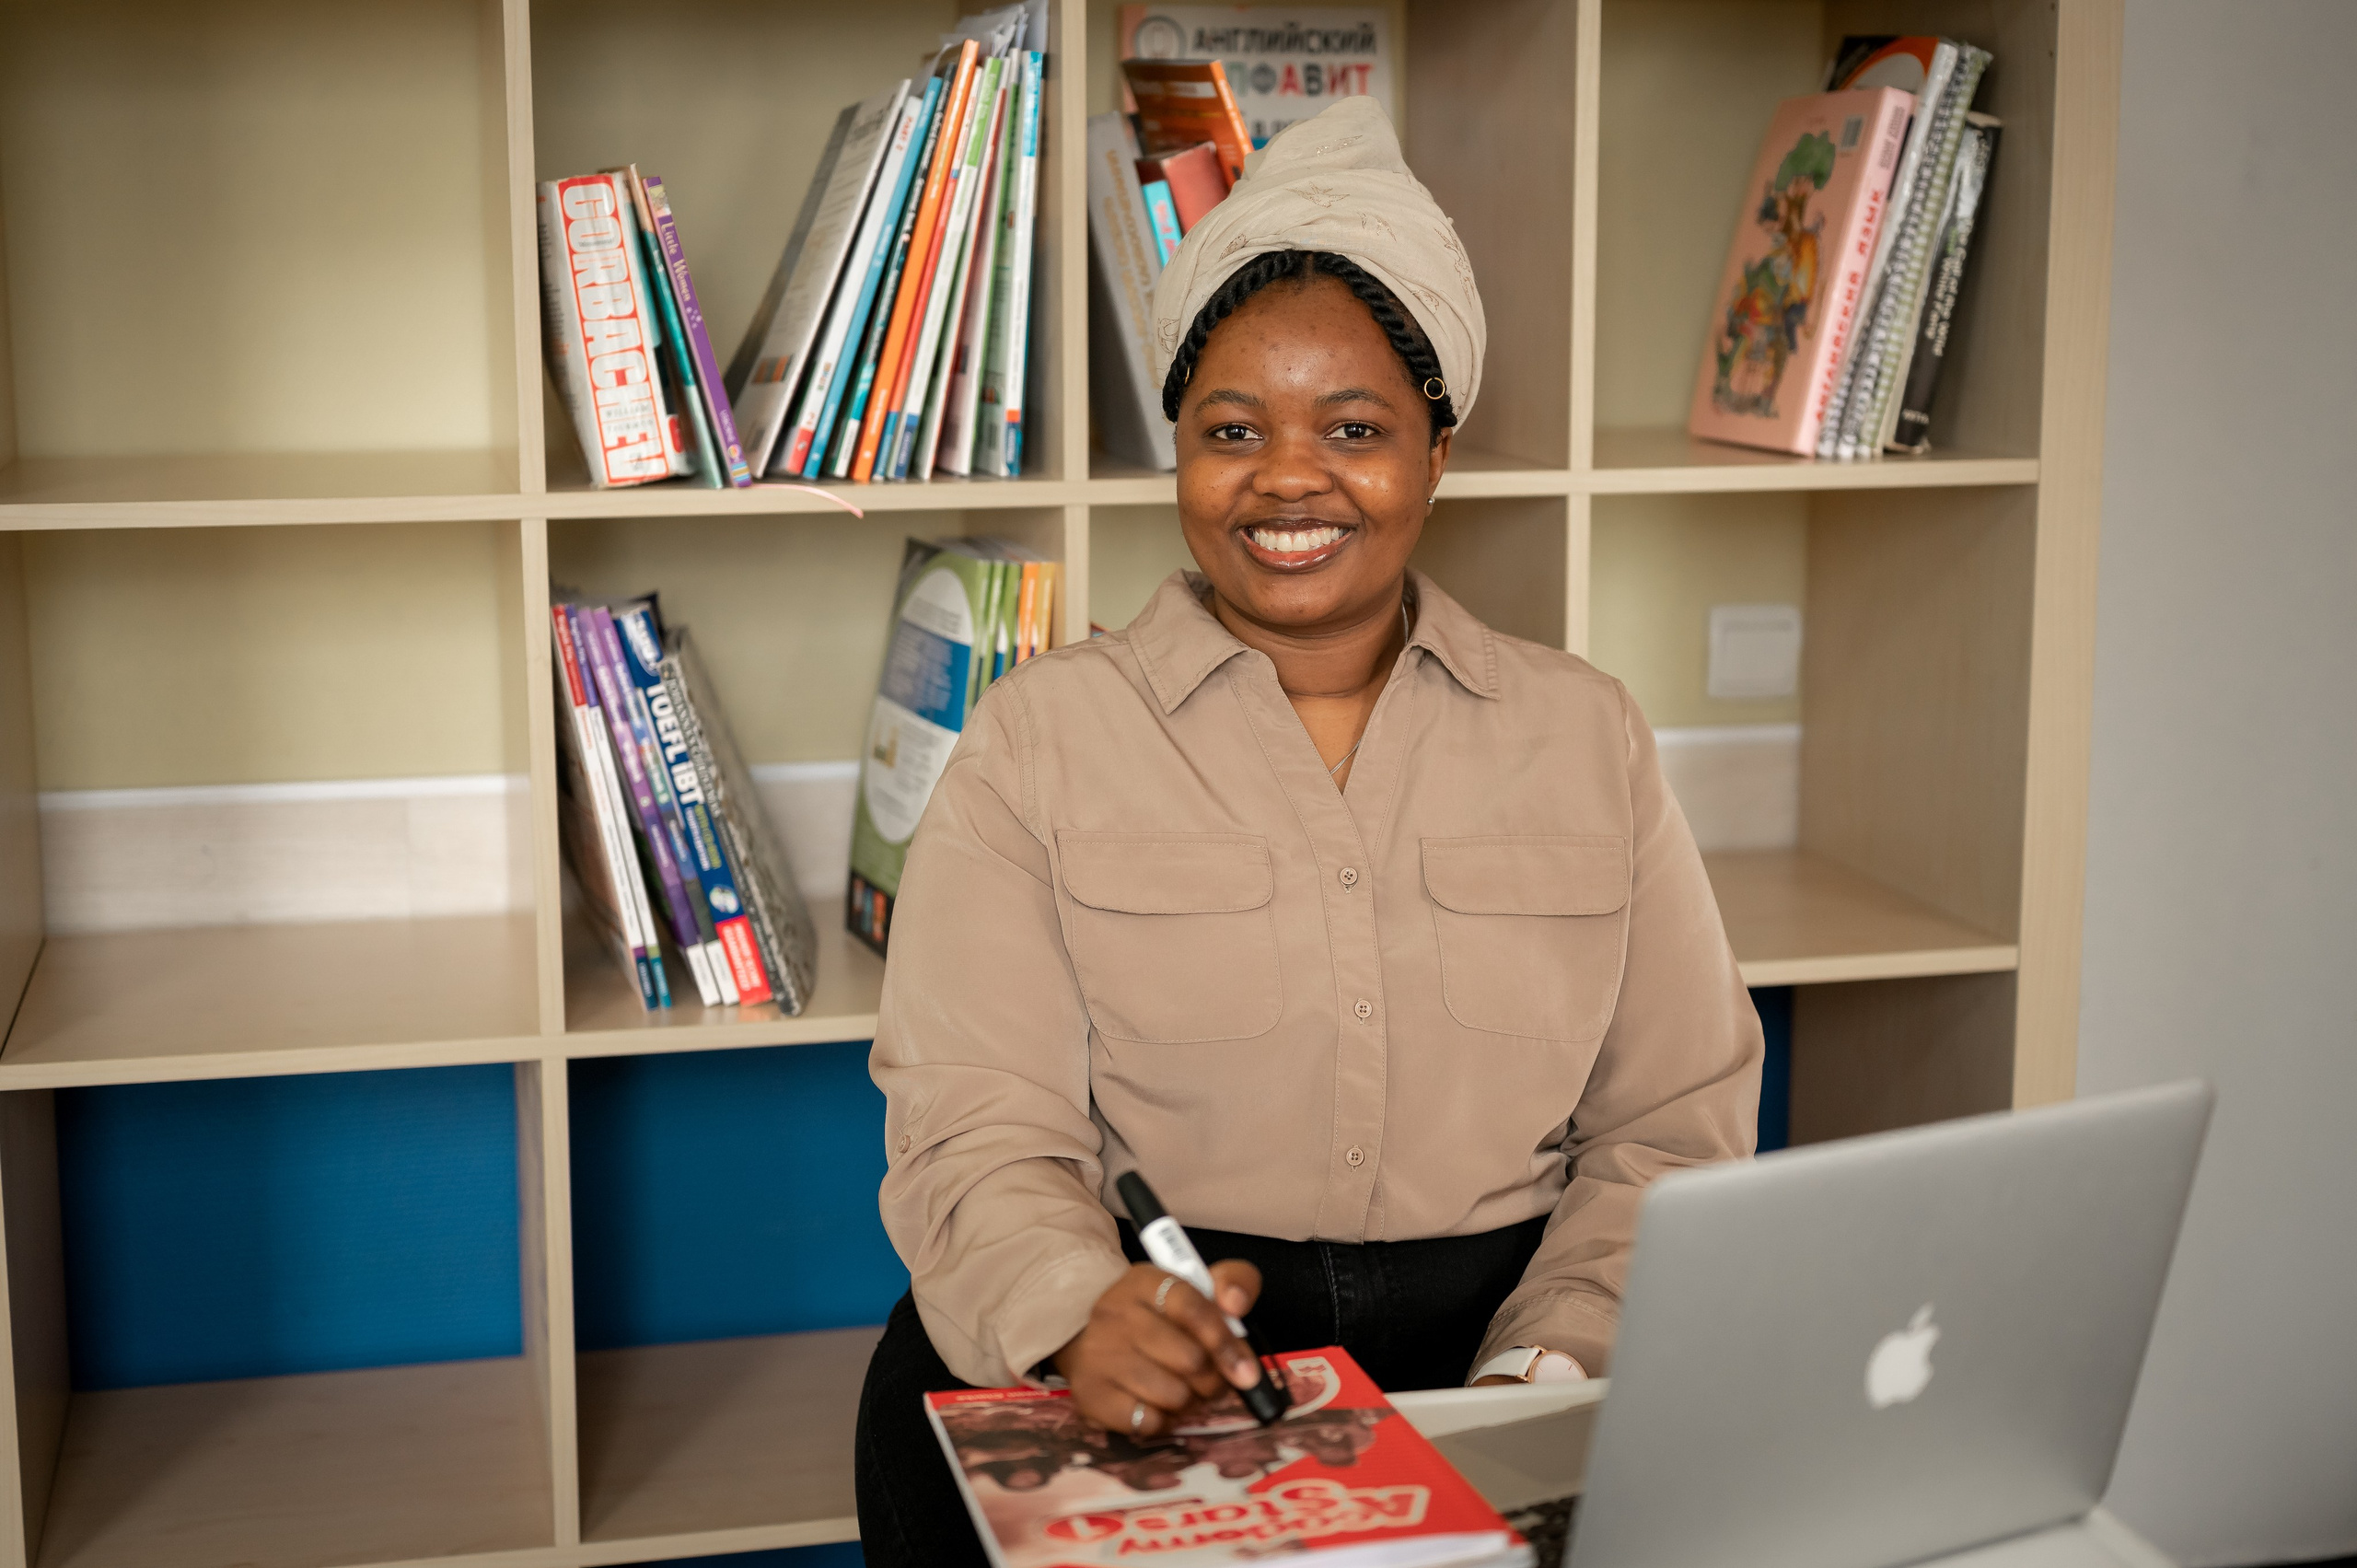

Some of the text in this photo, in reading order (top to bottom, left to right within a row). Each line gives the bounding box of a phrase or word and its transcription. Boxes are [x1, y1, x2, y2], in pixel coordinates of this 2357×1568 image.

[1192, 22, 1377, 54] АНГЛИЙСКИЙ
[1226, 62, 1375, 97] ЛФАВИТ
[1856, 190, 1882, 256] ЯЗЫК
[661, 221, 692, 301] Little Women
[563, 182, 666, 479] GORBACHEV
[645, 683, 690, 766] TOEFL
[673, 760, 705, 807] iBT
[1116, 1489, 1422, 1557] Academy
[1134, 1484, 1339, 1532] Stars
